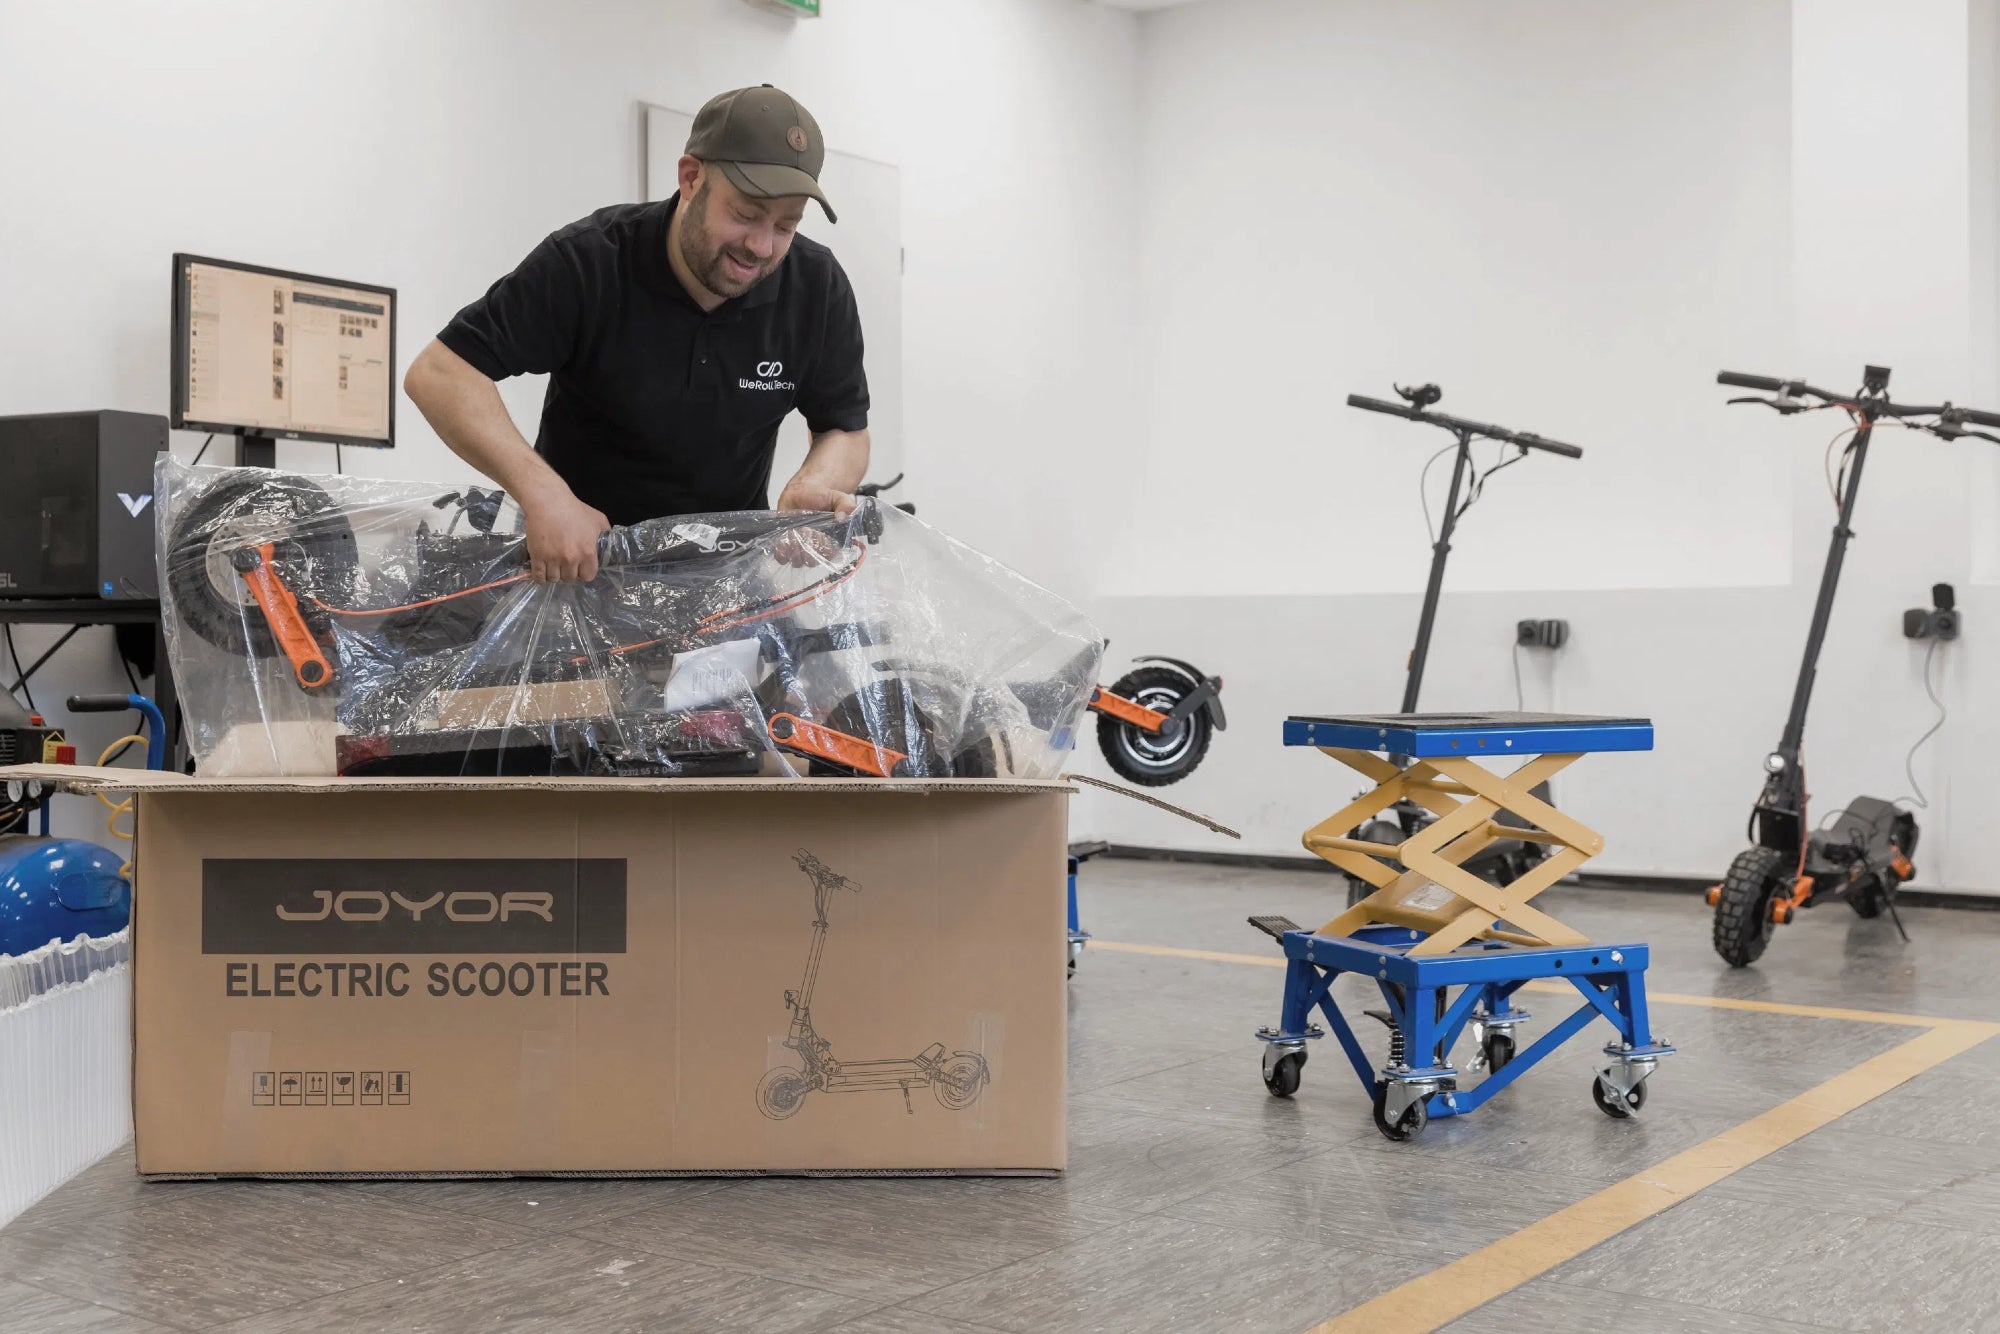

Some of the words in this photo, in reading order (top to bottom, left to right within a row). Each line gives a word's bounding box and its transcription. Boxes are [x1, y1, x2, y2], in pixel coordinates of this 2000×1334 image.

[276, 890, 553, 922] JOYOR
[226, 962, 410, 997] ELECTRIC
[426, 962, 610, 997] SCOOTER
